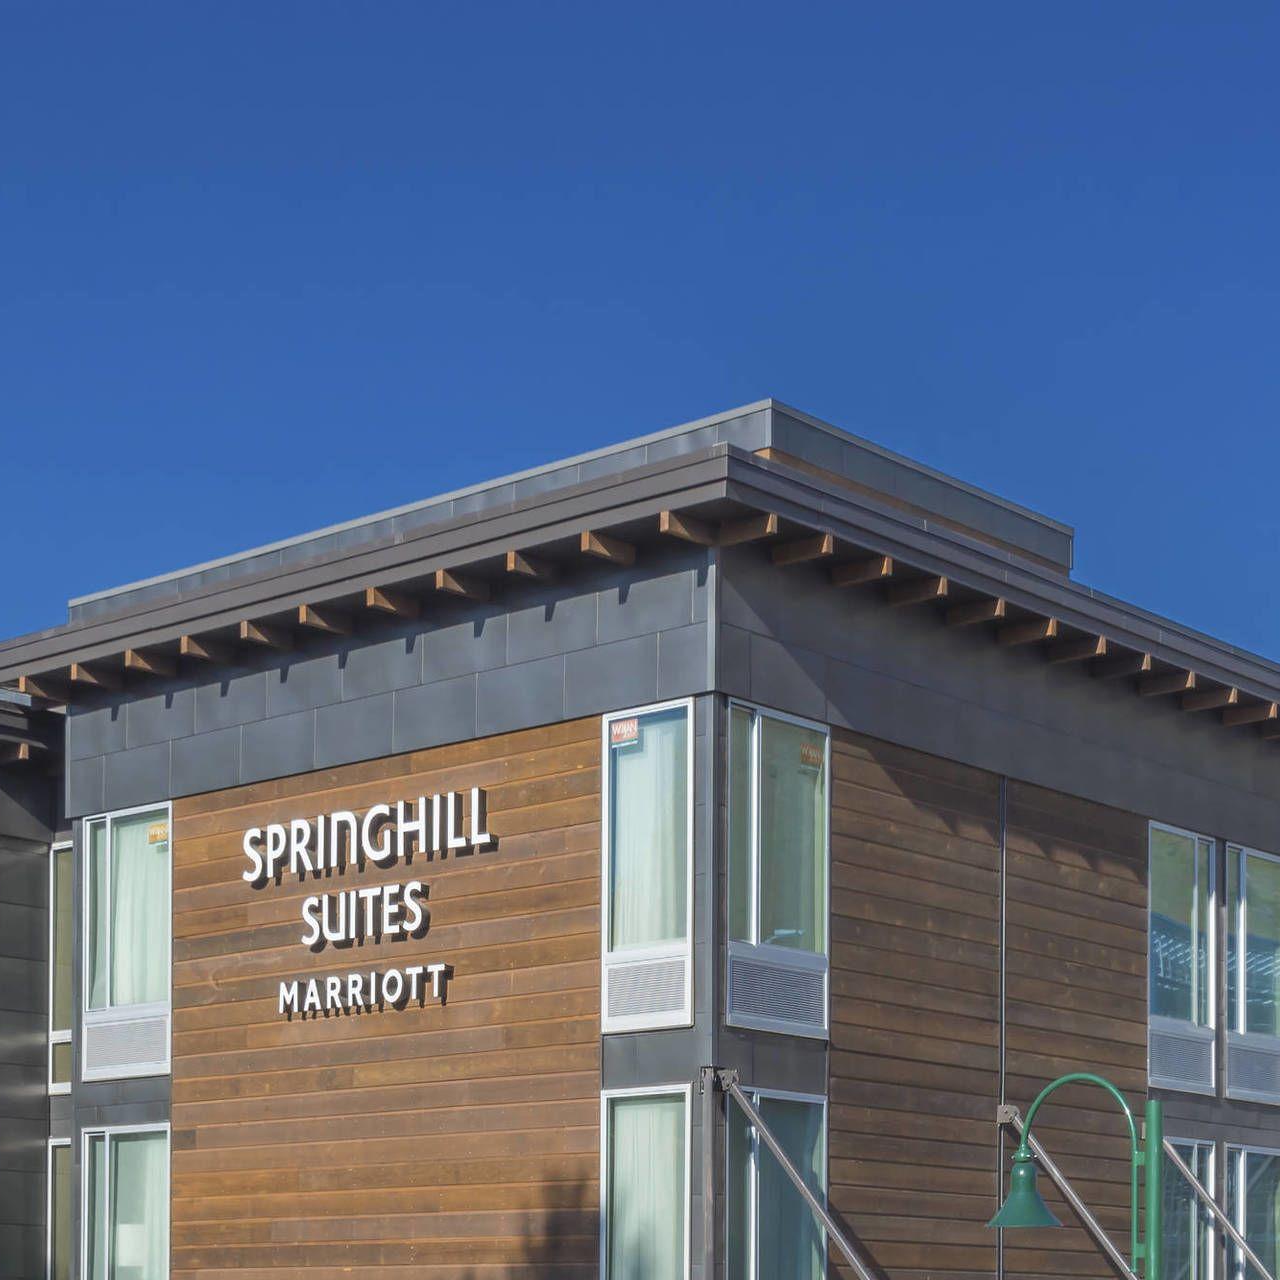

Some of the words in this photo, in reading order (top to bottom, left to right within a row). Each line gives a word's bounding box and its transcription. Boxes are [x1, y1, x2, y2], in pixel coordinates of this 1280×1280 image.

[242, 787, 491, 882] SPRINGHILL
[301, 881, 422, 945] SUITES
[278, 964, 446, 1014] MARRIOTT
